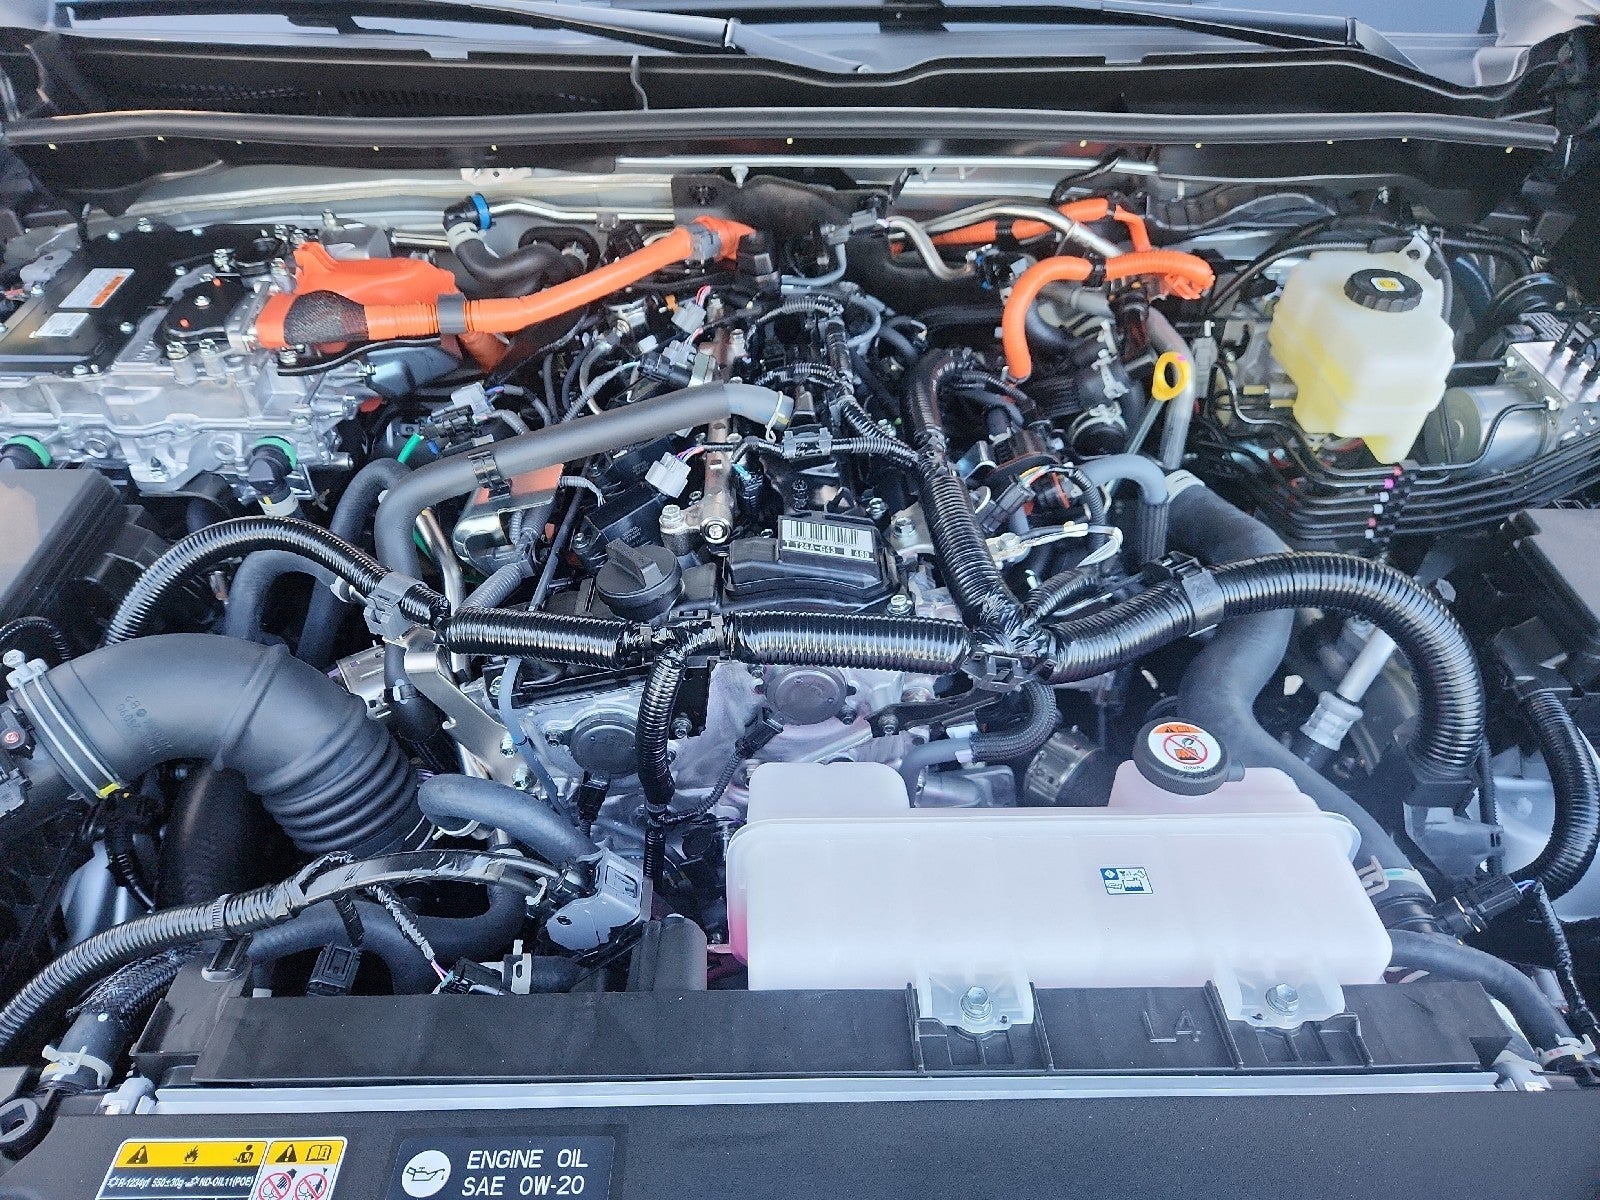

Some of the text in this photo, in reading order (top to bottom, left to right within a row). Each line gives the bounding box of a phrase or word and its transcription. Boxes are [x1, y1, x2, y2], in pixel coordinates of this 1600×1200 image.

[467, 1148, 589, 1169] ENGINE OIL
[199, 1175, 254, 1187] ND-OIL11(POE)
[461, 1175, 585, 1196] SAE 0W-20
